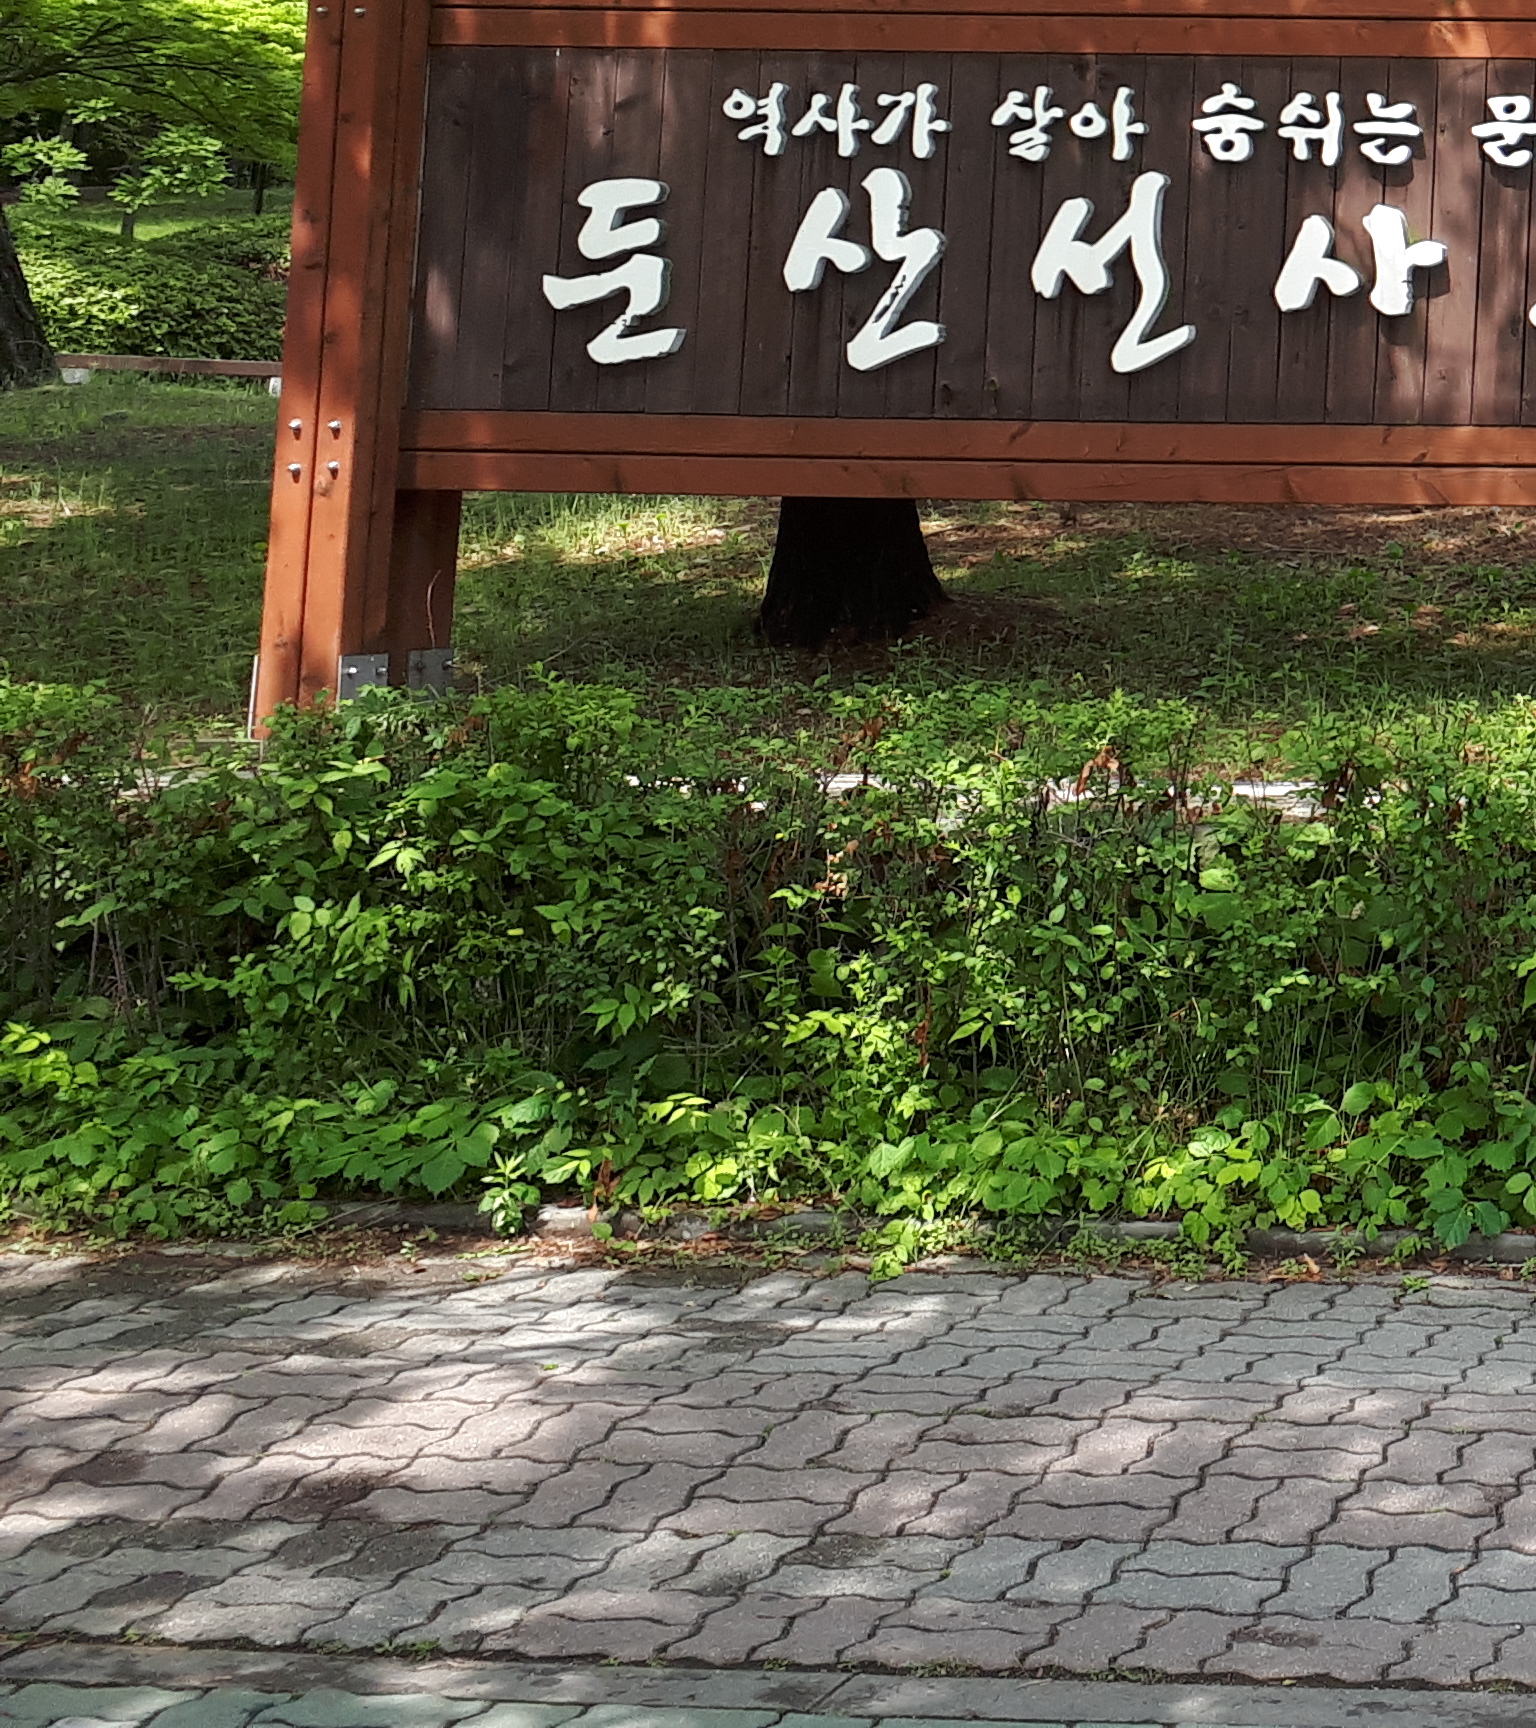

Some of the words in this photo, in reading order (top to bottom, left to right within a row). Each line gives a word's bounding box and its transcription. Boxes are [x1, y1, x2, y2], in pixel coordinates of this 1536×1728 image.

[722, 81, 950, 160] 역사가
[991, 85, 1147, 163] 살아
[1191, 82, 1424, 166] 숨쉬는
